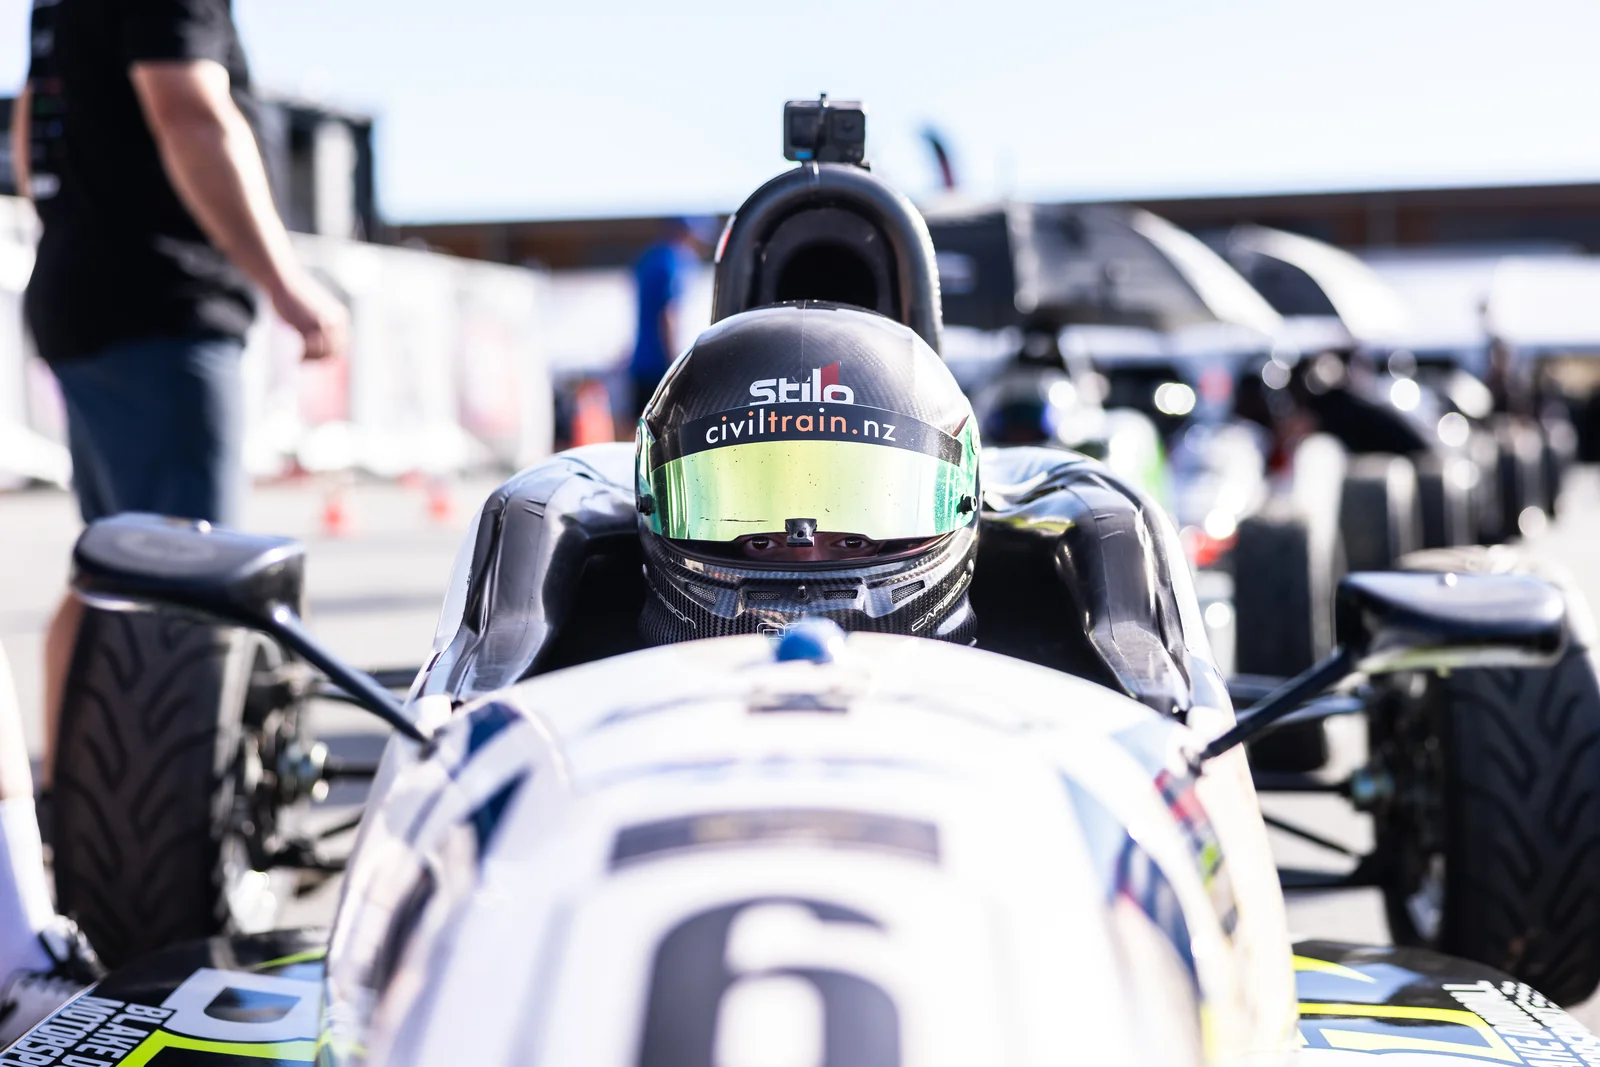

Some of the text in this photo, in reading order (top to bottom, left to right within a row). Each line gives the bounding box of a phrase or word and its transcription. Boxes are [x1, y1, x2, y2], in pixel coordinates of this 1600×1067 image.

[749, 361, 855, 405] Stilo
[705, 408, 896, 444] civiltrain.nz
[635, 896, 902, 1067] 6
[74, 1003, 173, 1059] BLAKE
